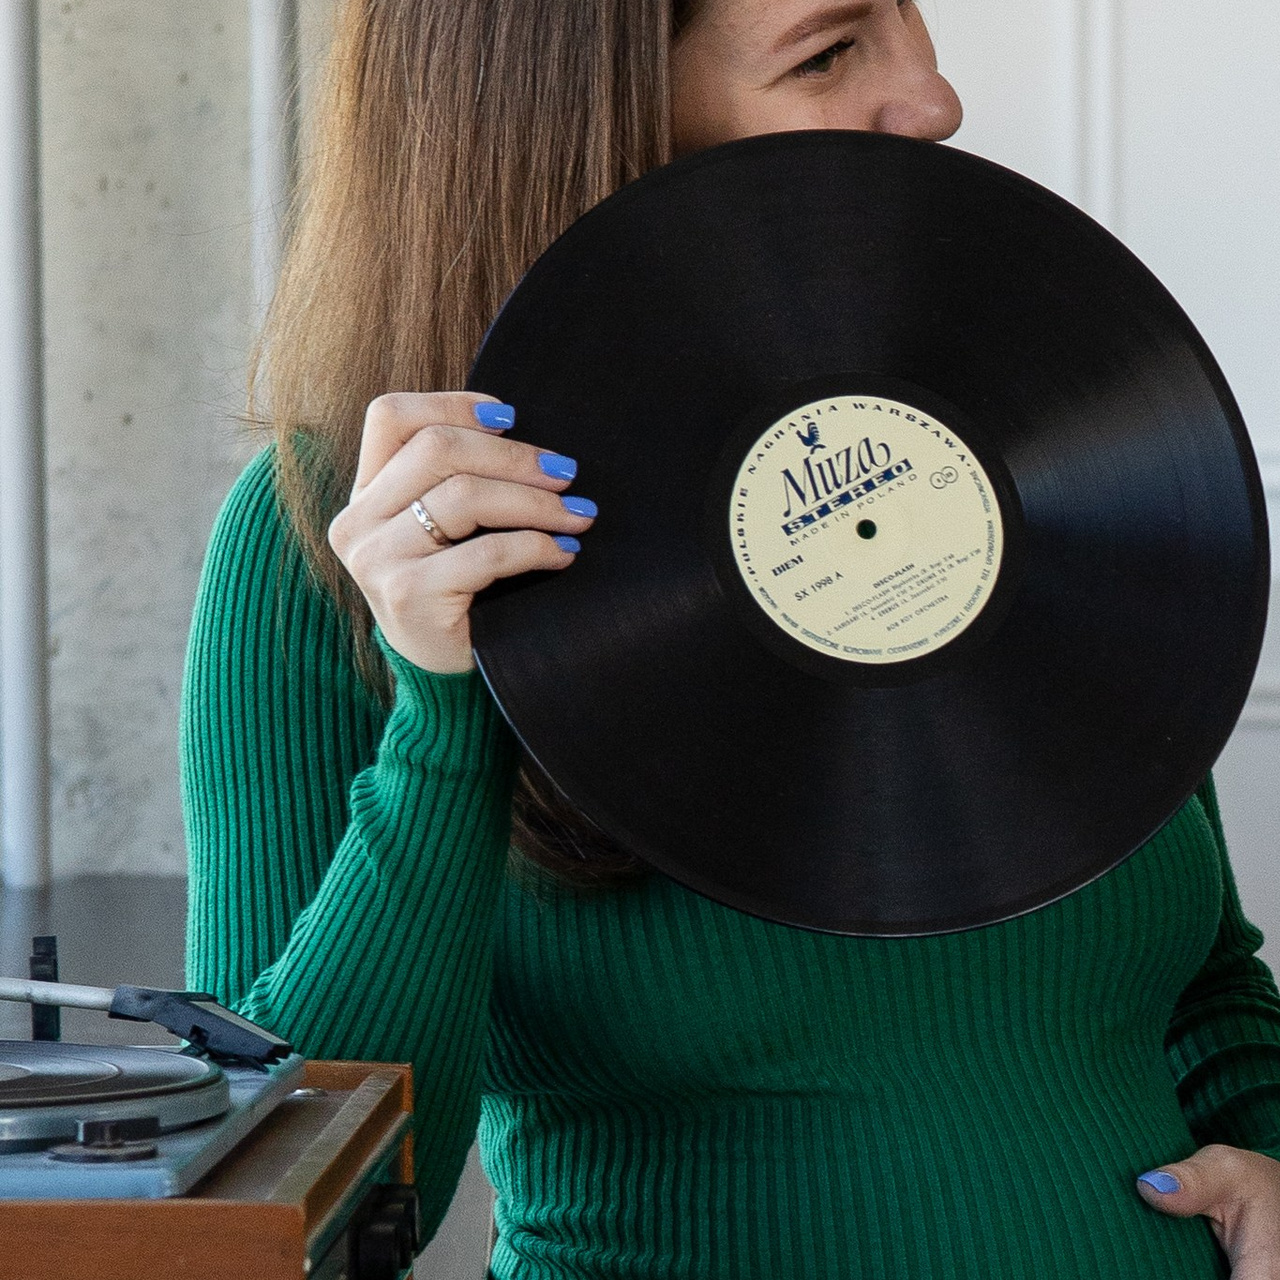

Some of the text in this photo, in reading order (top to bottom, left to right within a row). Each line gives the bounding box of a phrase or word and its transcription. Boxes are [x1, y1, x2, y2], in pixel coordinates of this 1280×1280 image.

[736, 402, 966, 576] POLSKIE NAGRANIA WARSZAWA
[780, 437, 891, 518] Muza
[785, 460, 911, 534] STEREO
[790, 521, 829, 546] MADE
[834, 509, 850, 523] IN
[857, 473, 919, 510] POLAND
[771, 555, 804, 577] BIEM
[794, 588, 810, 602] SX
[811, 576, 834, 595] 1998
